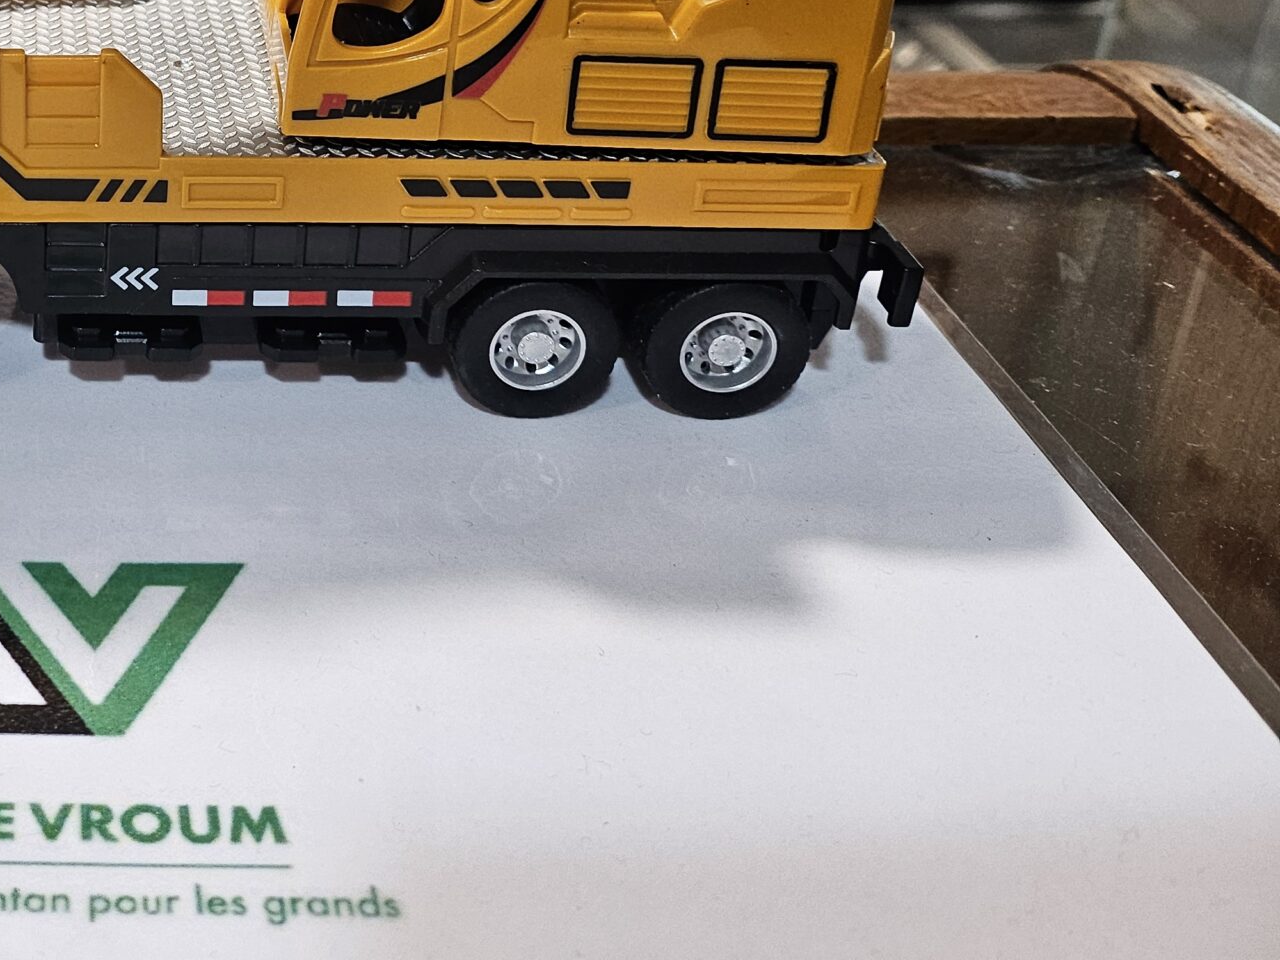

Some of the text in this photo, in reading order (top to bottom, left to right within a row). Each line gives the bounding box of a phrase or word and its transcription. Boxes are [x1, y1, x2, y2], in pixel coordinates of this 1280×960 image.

[316, 93, 420, 120] POWER
[29, 802, 291, 845] VROUM
[87, 888, 181, 922] pour
[195, 883, 247, 917] les
[263, 885, 401, 925] grands
